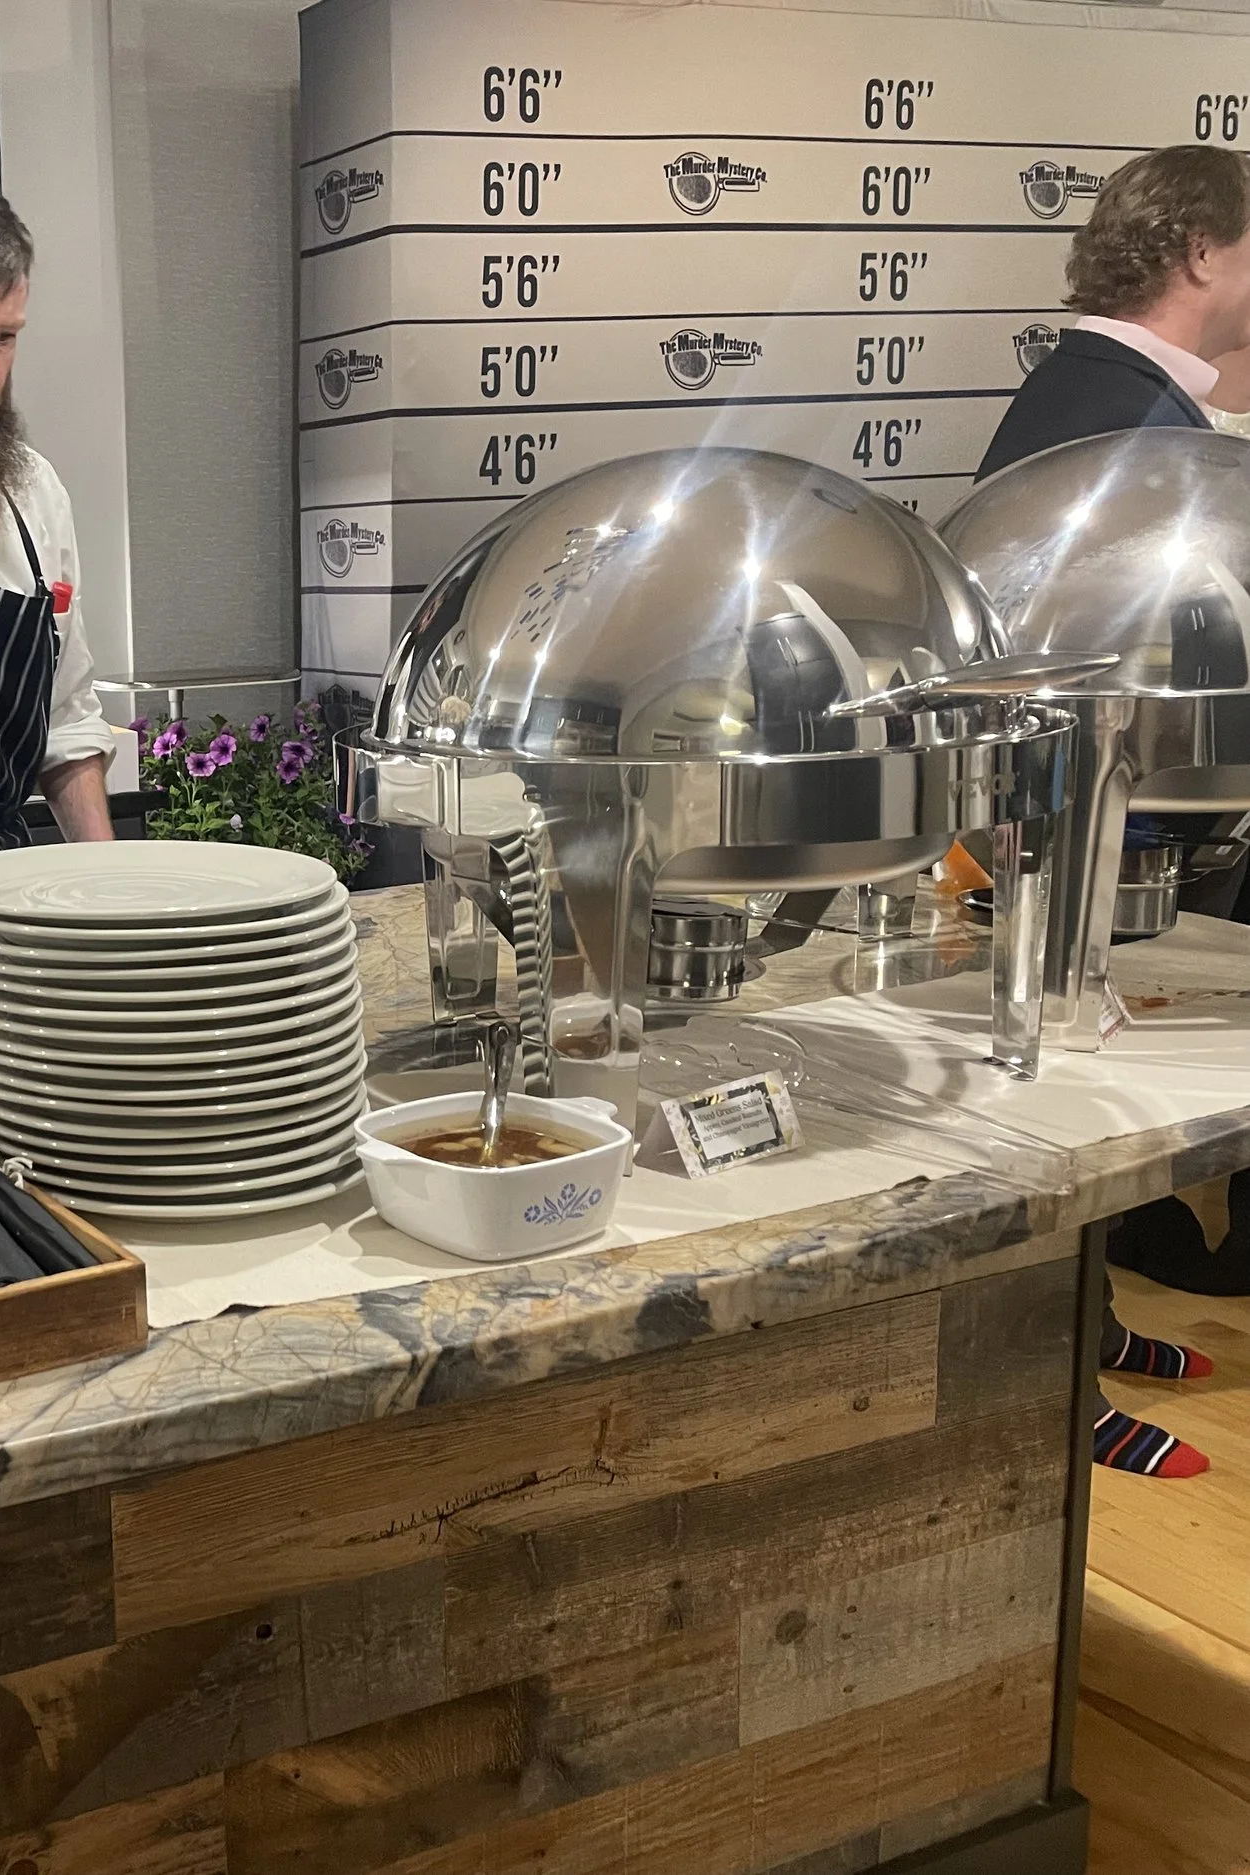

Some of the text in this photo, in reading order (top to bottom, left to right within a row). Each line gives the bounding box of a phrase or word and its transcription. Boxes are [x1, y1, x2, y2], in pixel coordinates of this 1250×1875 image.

[663, 162, 681, 178] The
[681, 157, 716, 175] Murder
[717, 156, 754, 180] Mystery
[1019, 171, 1034, 185] The
[1035, 166, 1065, 181] Murder
[1066, 165, 1098, 188] Mystery
[659, 333, 763, 357] The Murder Mystery Co.
[1012, 329, 1059, 348] The Murder
